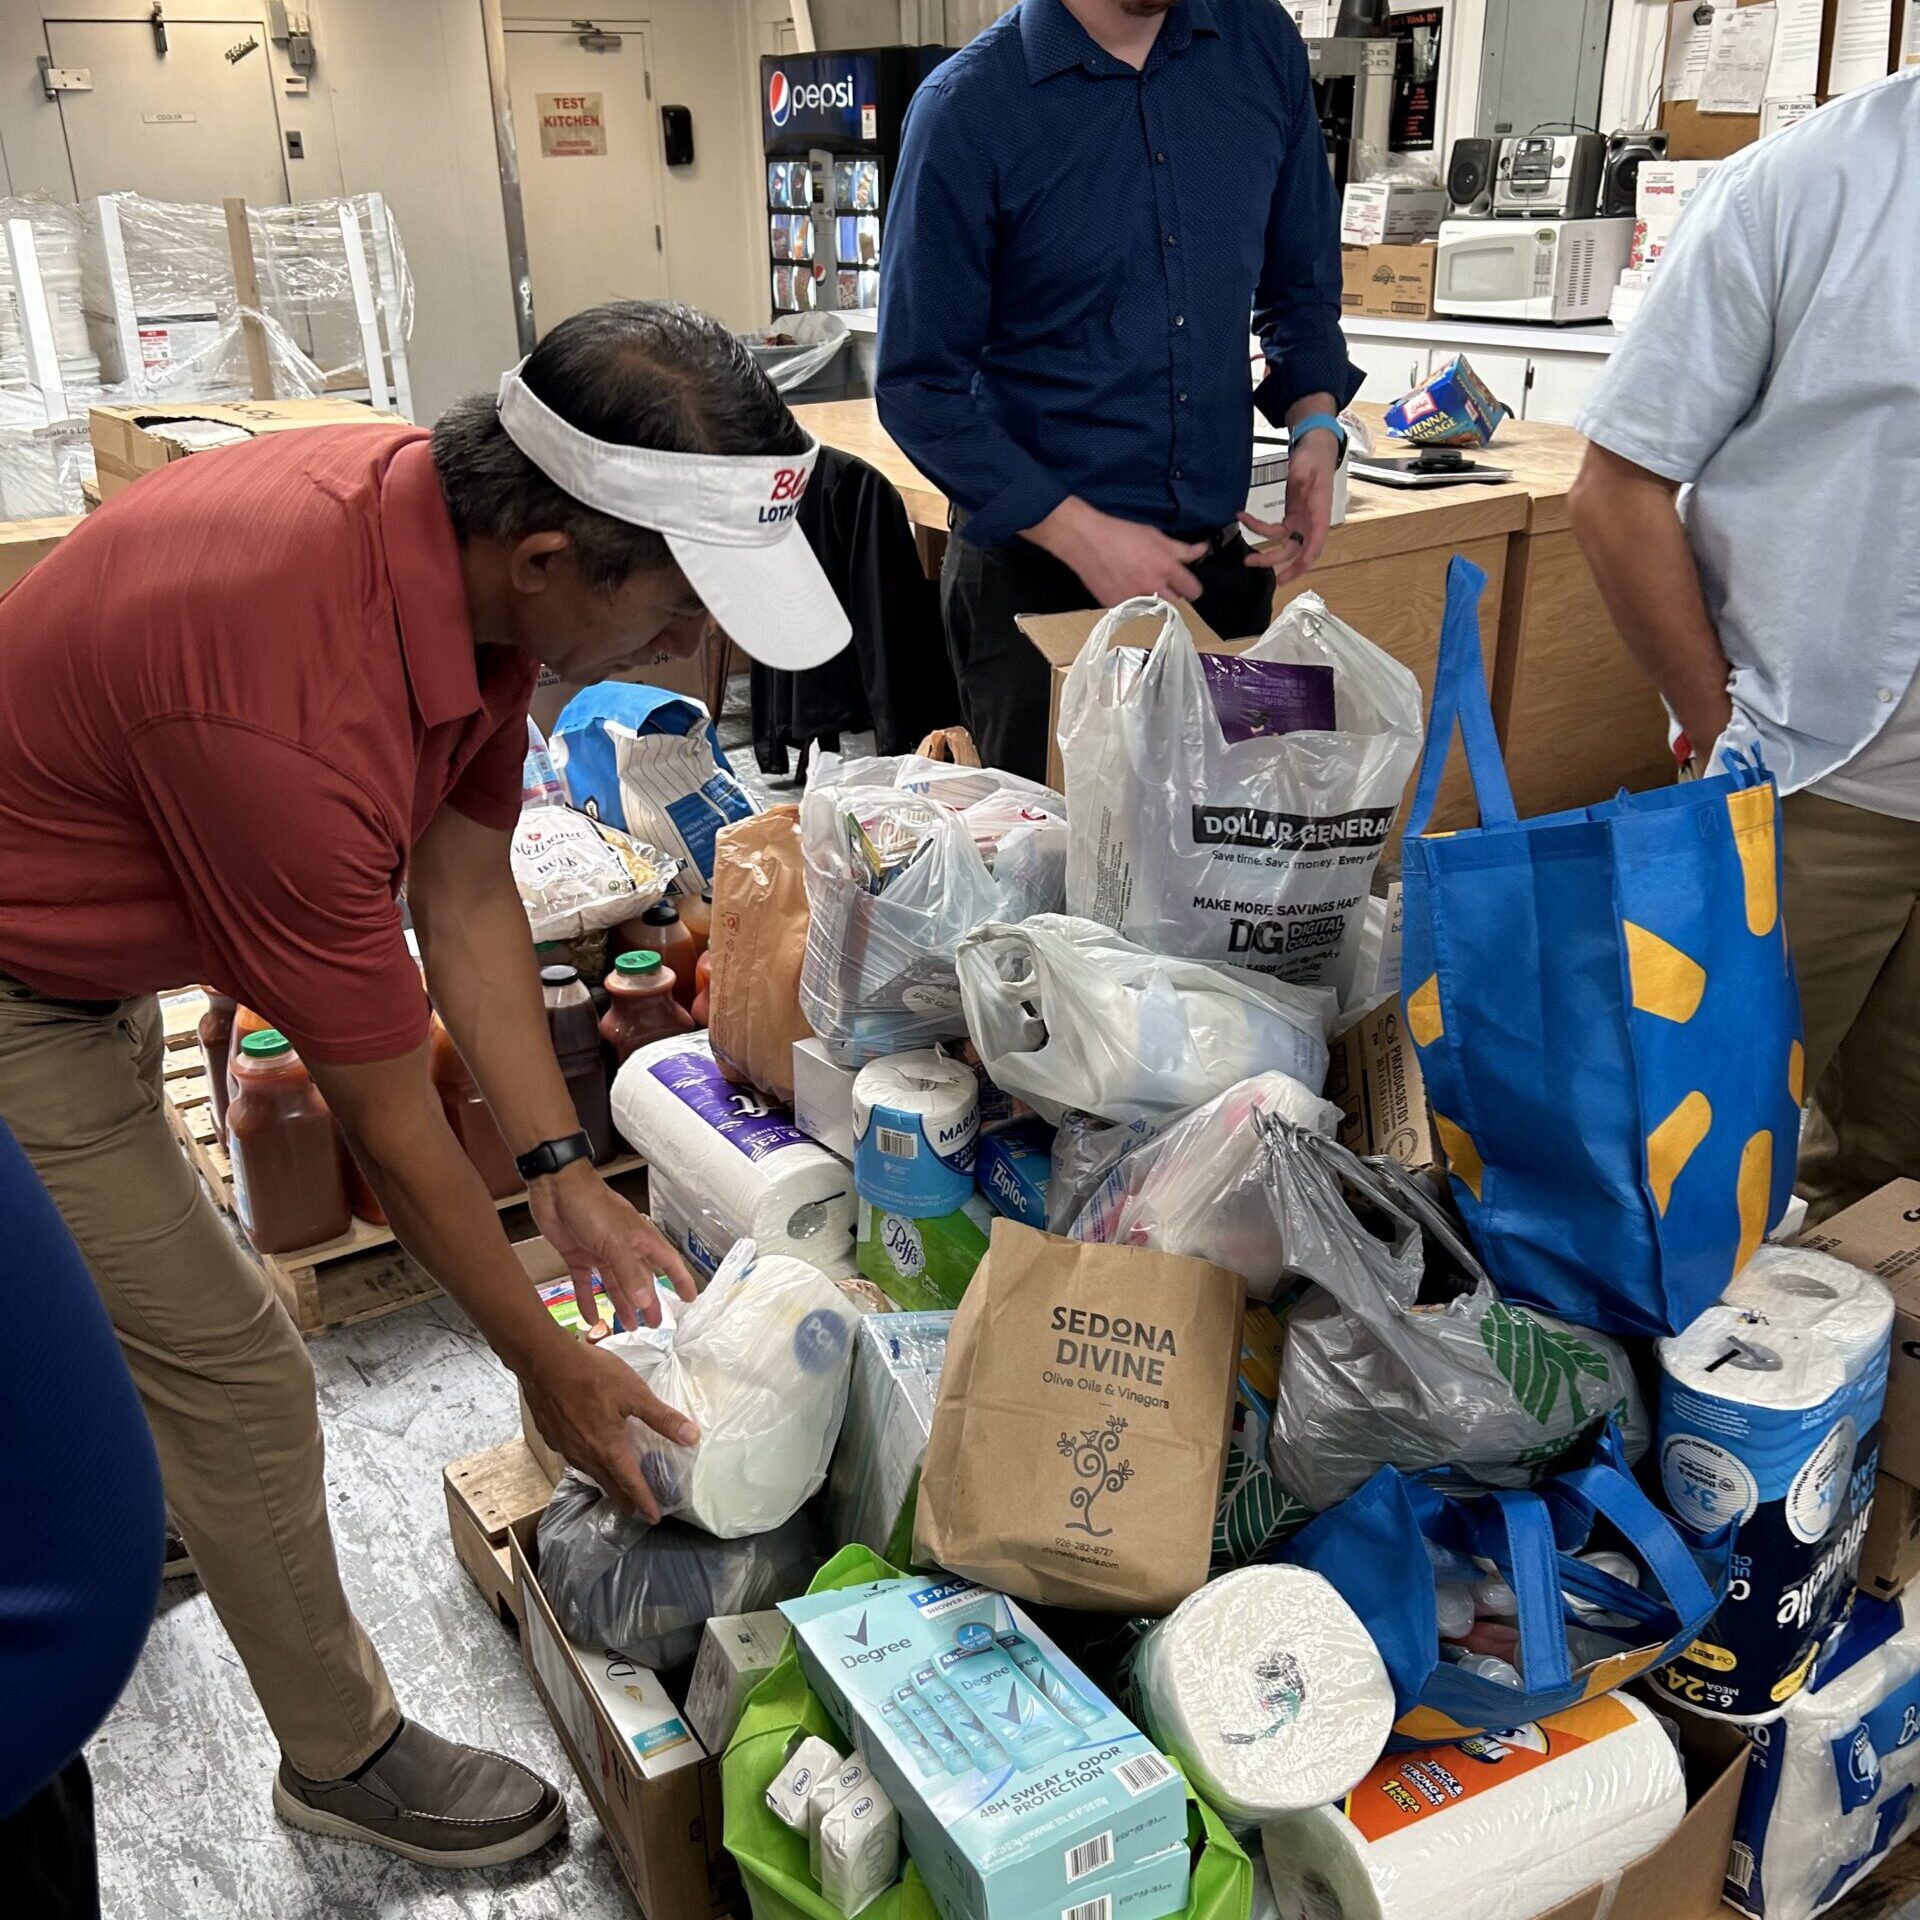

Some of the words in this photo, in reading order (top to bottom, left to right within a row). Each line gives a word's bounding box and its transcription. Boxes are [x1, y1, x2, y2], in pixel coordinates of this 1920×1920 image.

[553, 97, 586, 110] TEST
[792, 75, 854, 116] pepsi
[156, 113, 183, 121] COOLER
[543, 115, 600, 128] KITCHEN
[1403, 411, 1449, 437] VIENNA
[1203, 815, 1294, 844] DOLLAR
[1212, 850, 1235, 862] Save
[1237, 853, 1262, 866] time.
[1294, 859, 1336, 870] money.
[1338, 853, 1366, 866] Every
[1192, 896, 1231, 911] MAKE
[1234, 901, 1274, 916] MORE
[1276, 901, 1334, 916] SAVINGS
[1228, 917, 1284, 955] DG
[1290, 915, 1346, 938] DIGITAL
[992, 1162, 1028, 1214] Ziploc
[886, 1218, 918, 1266] Puffs
[1051, 1306, 1177, 1357] SEDONA
[1056, 1338, 1165, 1387] DIVINE
[1042, 1371, 1074, 1387] Olive
[1077, 1378, 1102, 1393] Oils
[1105, 1383, 1115, 1395] &
[1118, 1385, 1170, 1409] Vinegars
[1055, 1537, 1114, 1556] 928-282-8727
[926, 1597, 962, 1615] SHOWER
[840, 1636, 912, 1670] Degree
[1691, 1647, 1715, 1661] BEST
[1716, 1655, 1733, 1666] Our
[961, 1665, 1011, 1691] Degree
[1666, 1666, 1706, 1702] 24
[1705, 1681, 1739, 1696] MEGA
[1719, 1694, 1733, 1708] 6
[794, 1771, 810, 1793] Dial
[842, 1769, 859, 1785] Dial
[980, 1799, 1009, 1819] 48H
[1011, 1775, 1063, 1805] SWEAT
[1065, 1768, 1077, 1779] &
[1078, 1746, 1122, 1771] ODOR
[1400, 1763, 1440, 1794] STRONG
[1435, 1793, 1446, 1804] &
[1401, 1772, 1441, 1807] ABSORBENT
[1426, 1759, 1458, 1786] THICK
[1452, 1785, 1464, 1796] &
[1429, 1770, 1458, 1799] LASTING
[1012, 1767, 1106, 1816] PROTECTION
[1382, 1780, 1400, 1792] 1
[1395, 1787, 1421, 1813] MEGA
[1387, 1789, 1410, 1813] ROLL
[853, 1800, 871, 1817] Dial
